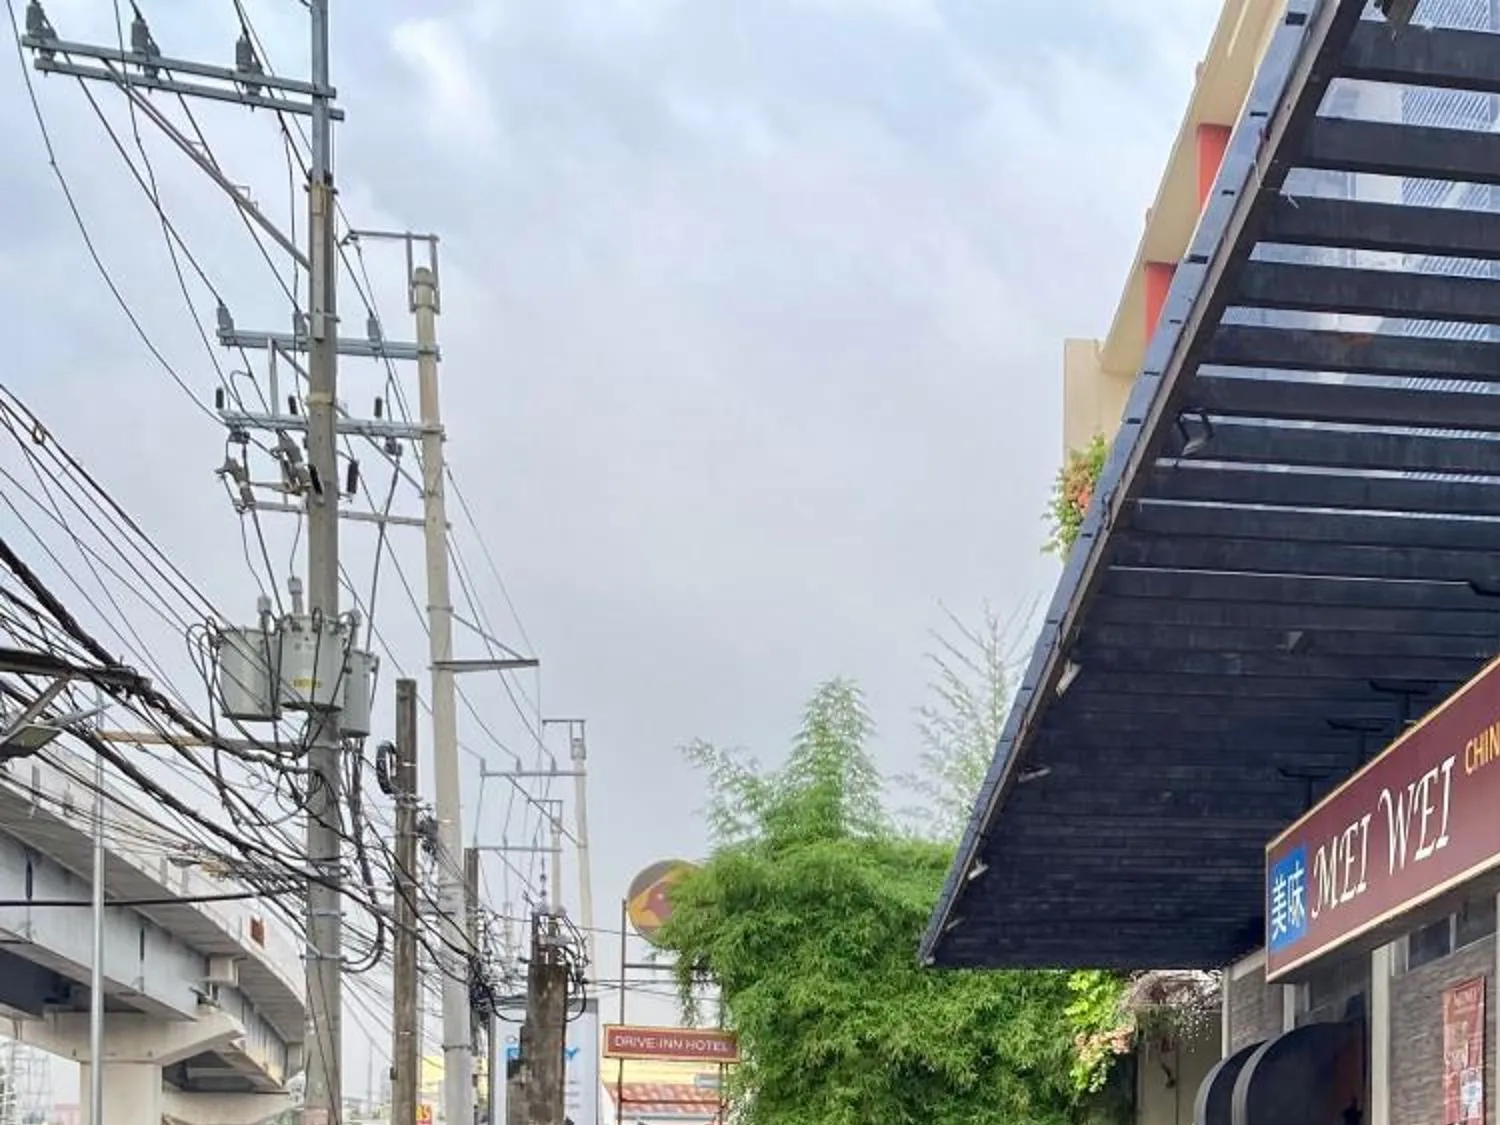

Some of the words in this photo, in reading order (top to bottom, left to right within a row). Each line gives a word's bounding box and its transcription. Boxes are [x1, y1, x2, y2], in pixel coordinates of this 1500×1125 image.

[1310, 814, 1372, 919] MEI
[1378, 754, 1457, 876] WEI
[1270, 861, 1306, 940] 美味
[614, 1034, 657, 1050] DRIVE
[659, 1038, 684, 1051] INN
[685, 1039, 729, 1053] HOTEL
